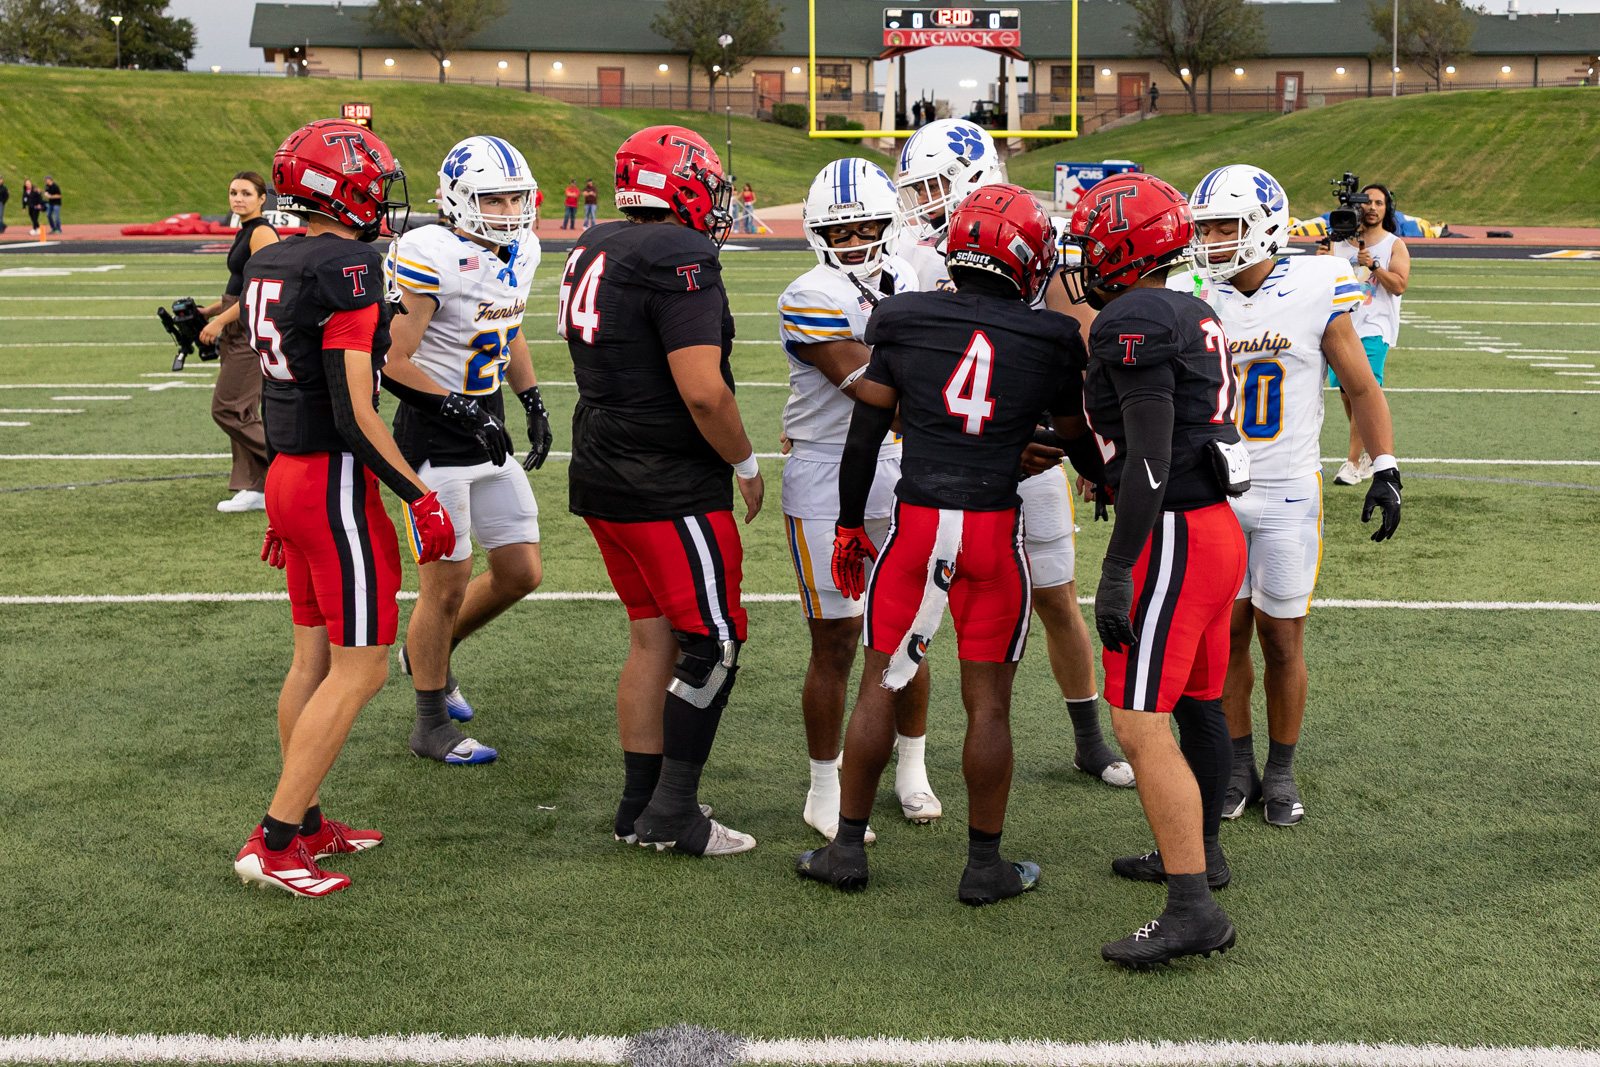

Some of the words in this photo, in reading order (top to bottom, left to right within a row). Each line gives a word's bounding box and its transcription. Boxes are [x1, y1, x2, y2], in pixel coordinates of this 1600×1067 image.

[322, 131, 363, 174] T
[670, 135, 706, 181] T
[346, 211, 366, 227] schutt
[1096, 185, 1138, 233] T
[969, 221, 981, 242] 4
[956, 251, 991, 264] schutt
[343, 264, 369, 297] T
[676, 263, 701, 292] T
[557, 246, 606, 346] 64
[245, 277, 297, 382] 15
[1229, 330, 1292, 356] enship
[1118, 334, 1145, 366] T
[942, 329, 996, 437] 4
